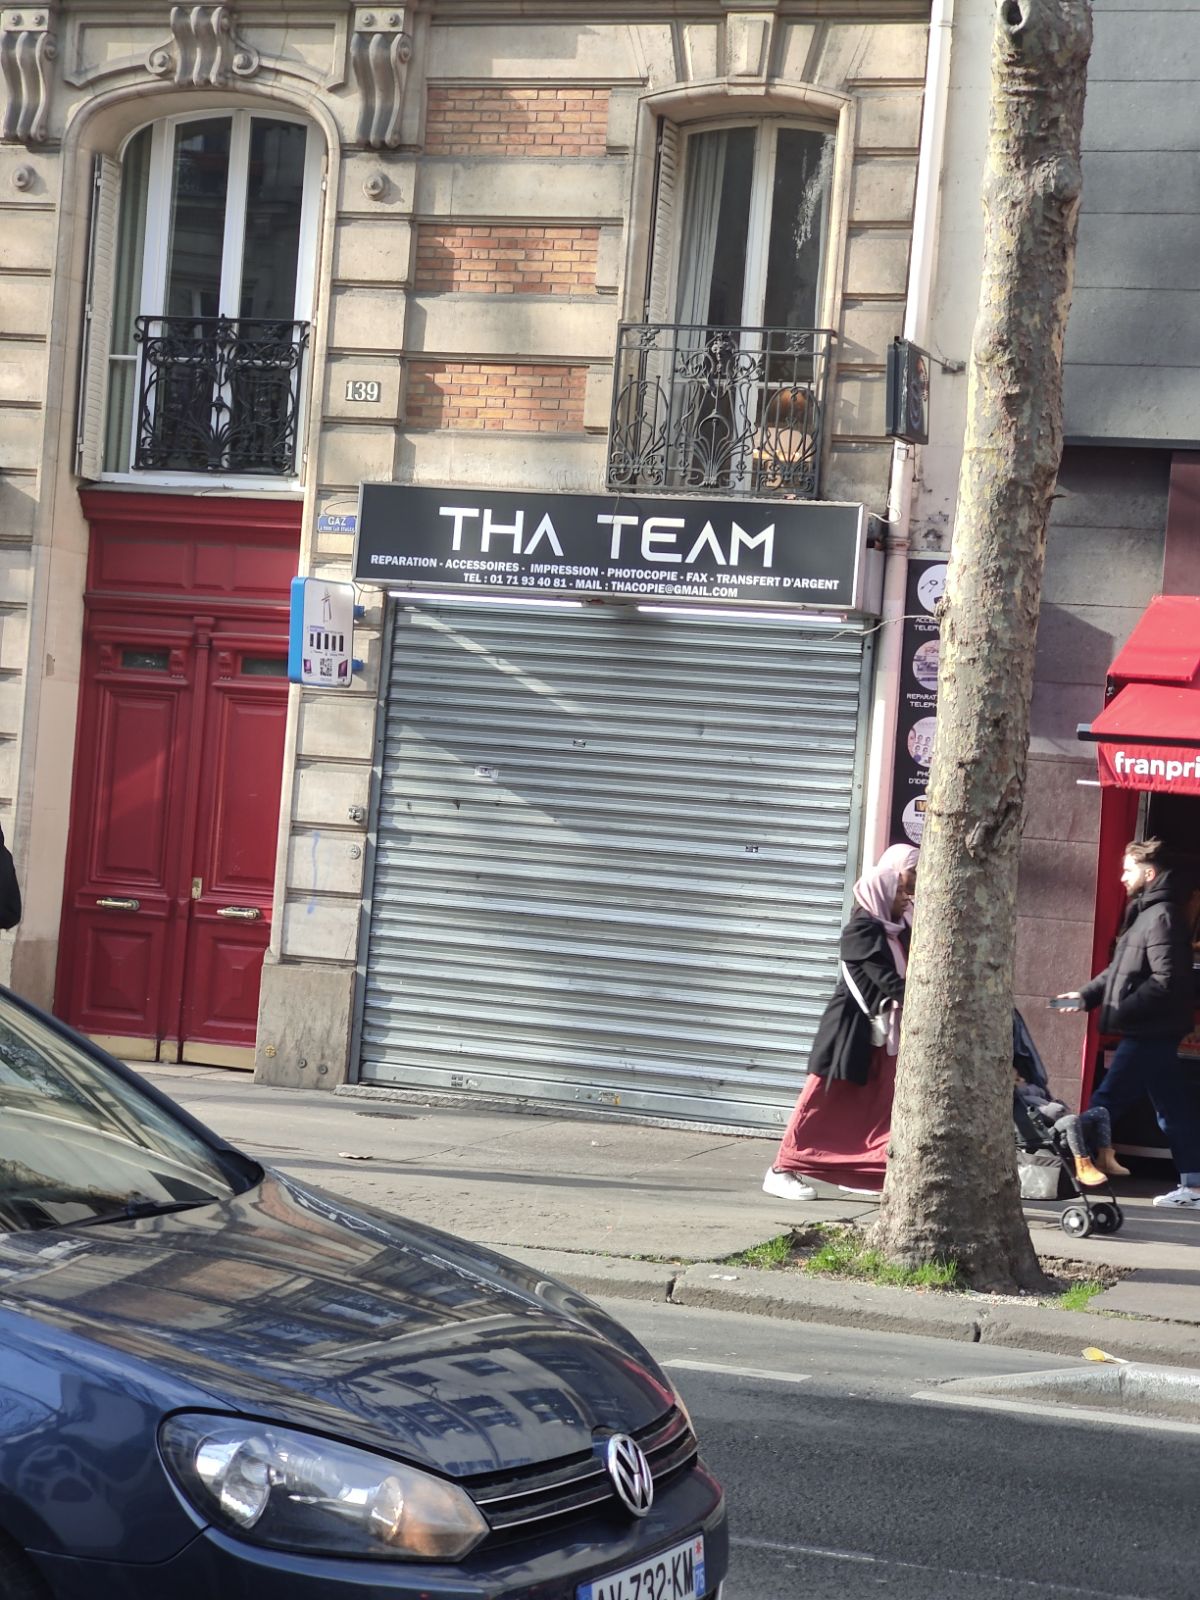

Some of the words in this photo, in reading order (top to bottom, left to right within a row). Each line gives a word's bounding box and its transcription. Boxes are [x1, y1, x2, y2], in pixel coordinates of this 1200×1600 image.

[346, 381, 378, 401] 139
[327, 516, 346, 526] GAZ
[439, 506, 564, 557] THA
[597, 513, 775, 568] TEAM
[370, 554, 437, 567] REPARATION
[445, 559, 519, 572] ACCESSOIRES
[530, 563, 598, 577] IMPRESSION
[607, 567, 678, 581] PHOTOCOPIE
[686, 572, 708, 583] FAX
[716, 574, 781, 587] TRANSFERT
[783, 577, 840, 590] D'ARGENT
[463, 572, 481, 583] TEL
[490, 574, 503, 585] 01
[506, 575, 519, 585] 71
[521, 576, 535, 586] 93
[537, 577, 551, 587] 40
[553, 578, 567, 588] 81
[575, 579, 602, 590] MAIL
[611, 581, 738, 598] THACOPIE@GMAIL.COM
[1115, 751, 1200, 781] franpri
